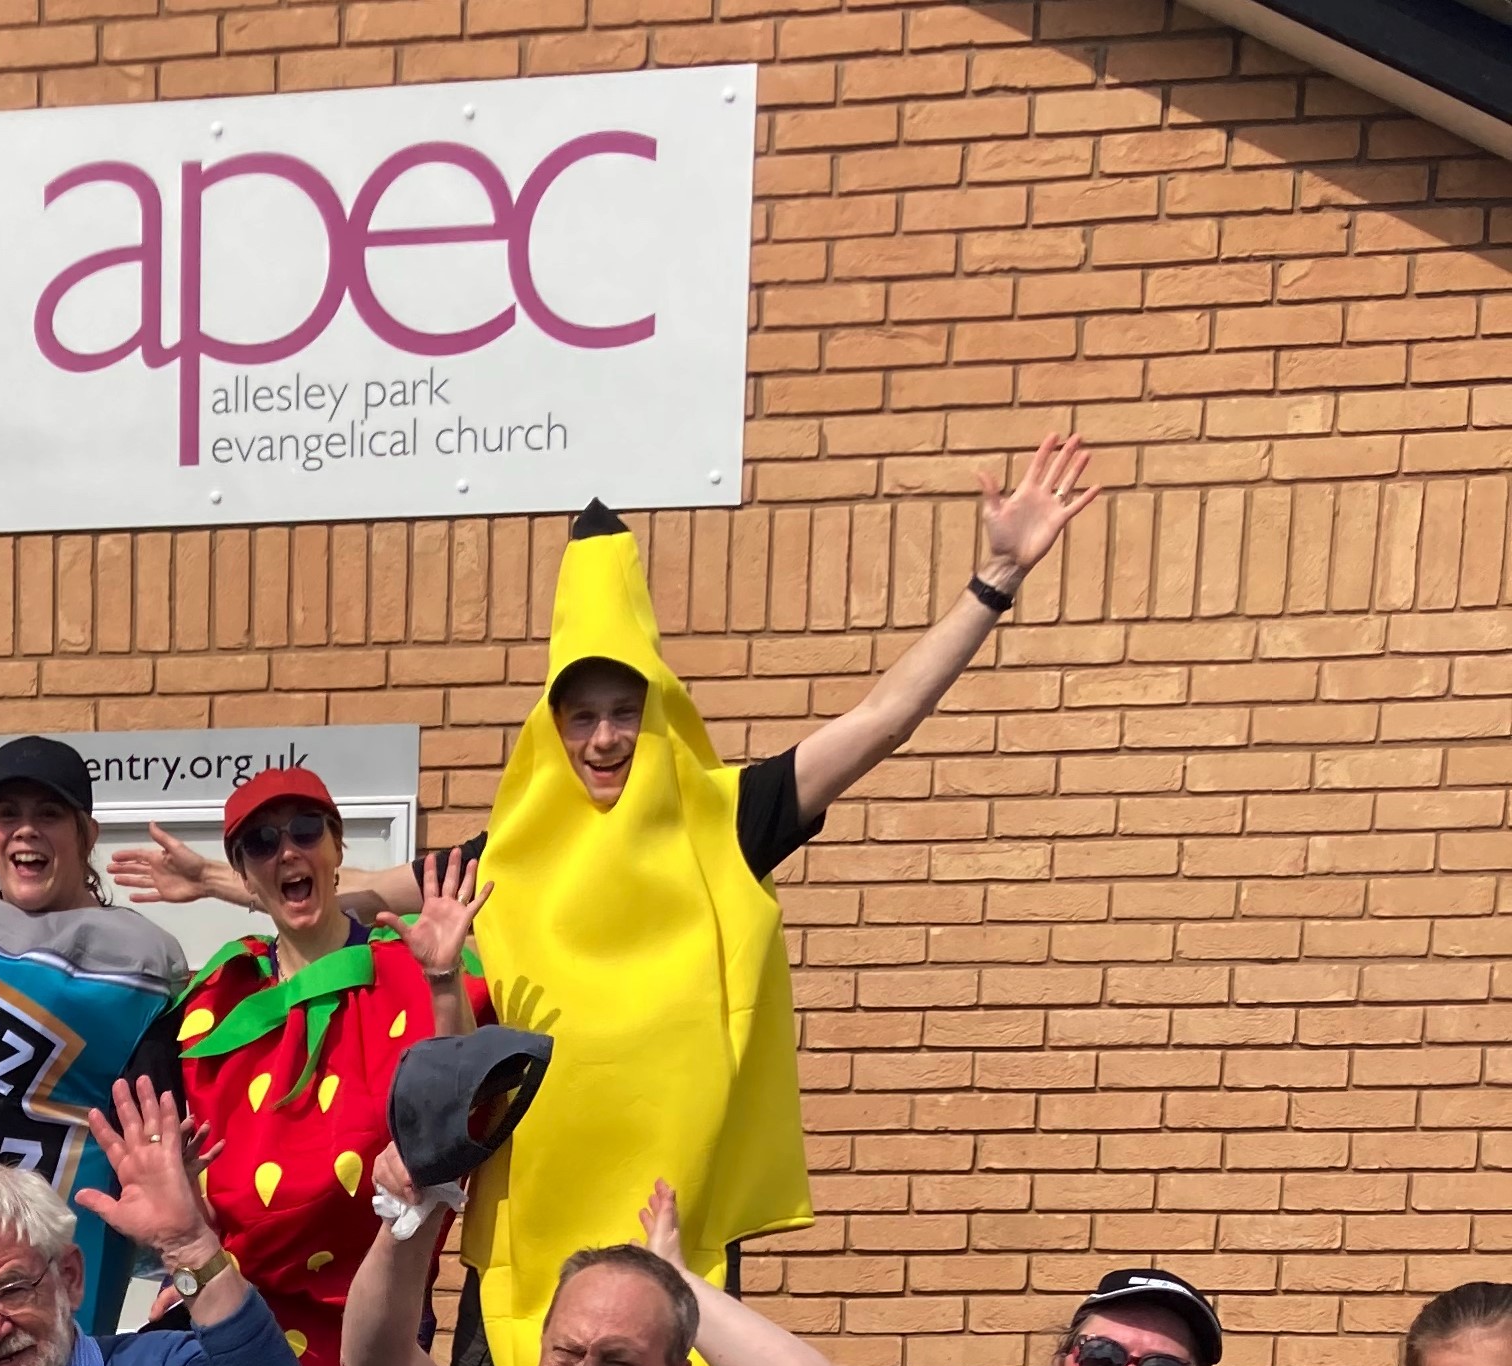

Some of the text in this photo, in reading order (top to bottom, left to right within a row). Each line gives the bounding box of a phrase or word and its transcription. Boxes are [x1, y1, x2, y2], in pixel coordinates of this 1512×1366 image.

[34, 130, 657, 466] apec
[212, 366, 450, 422] allesley park
[212, 412, 568, 471] evangelical church
